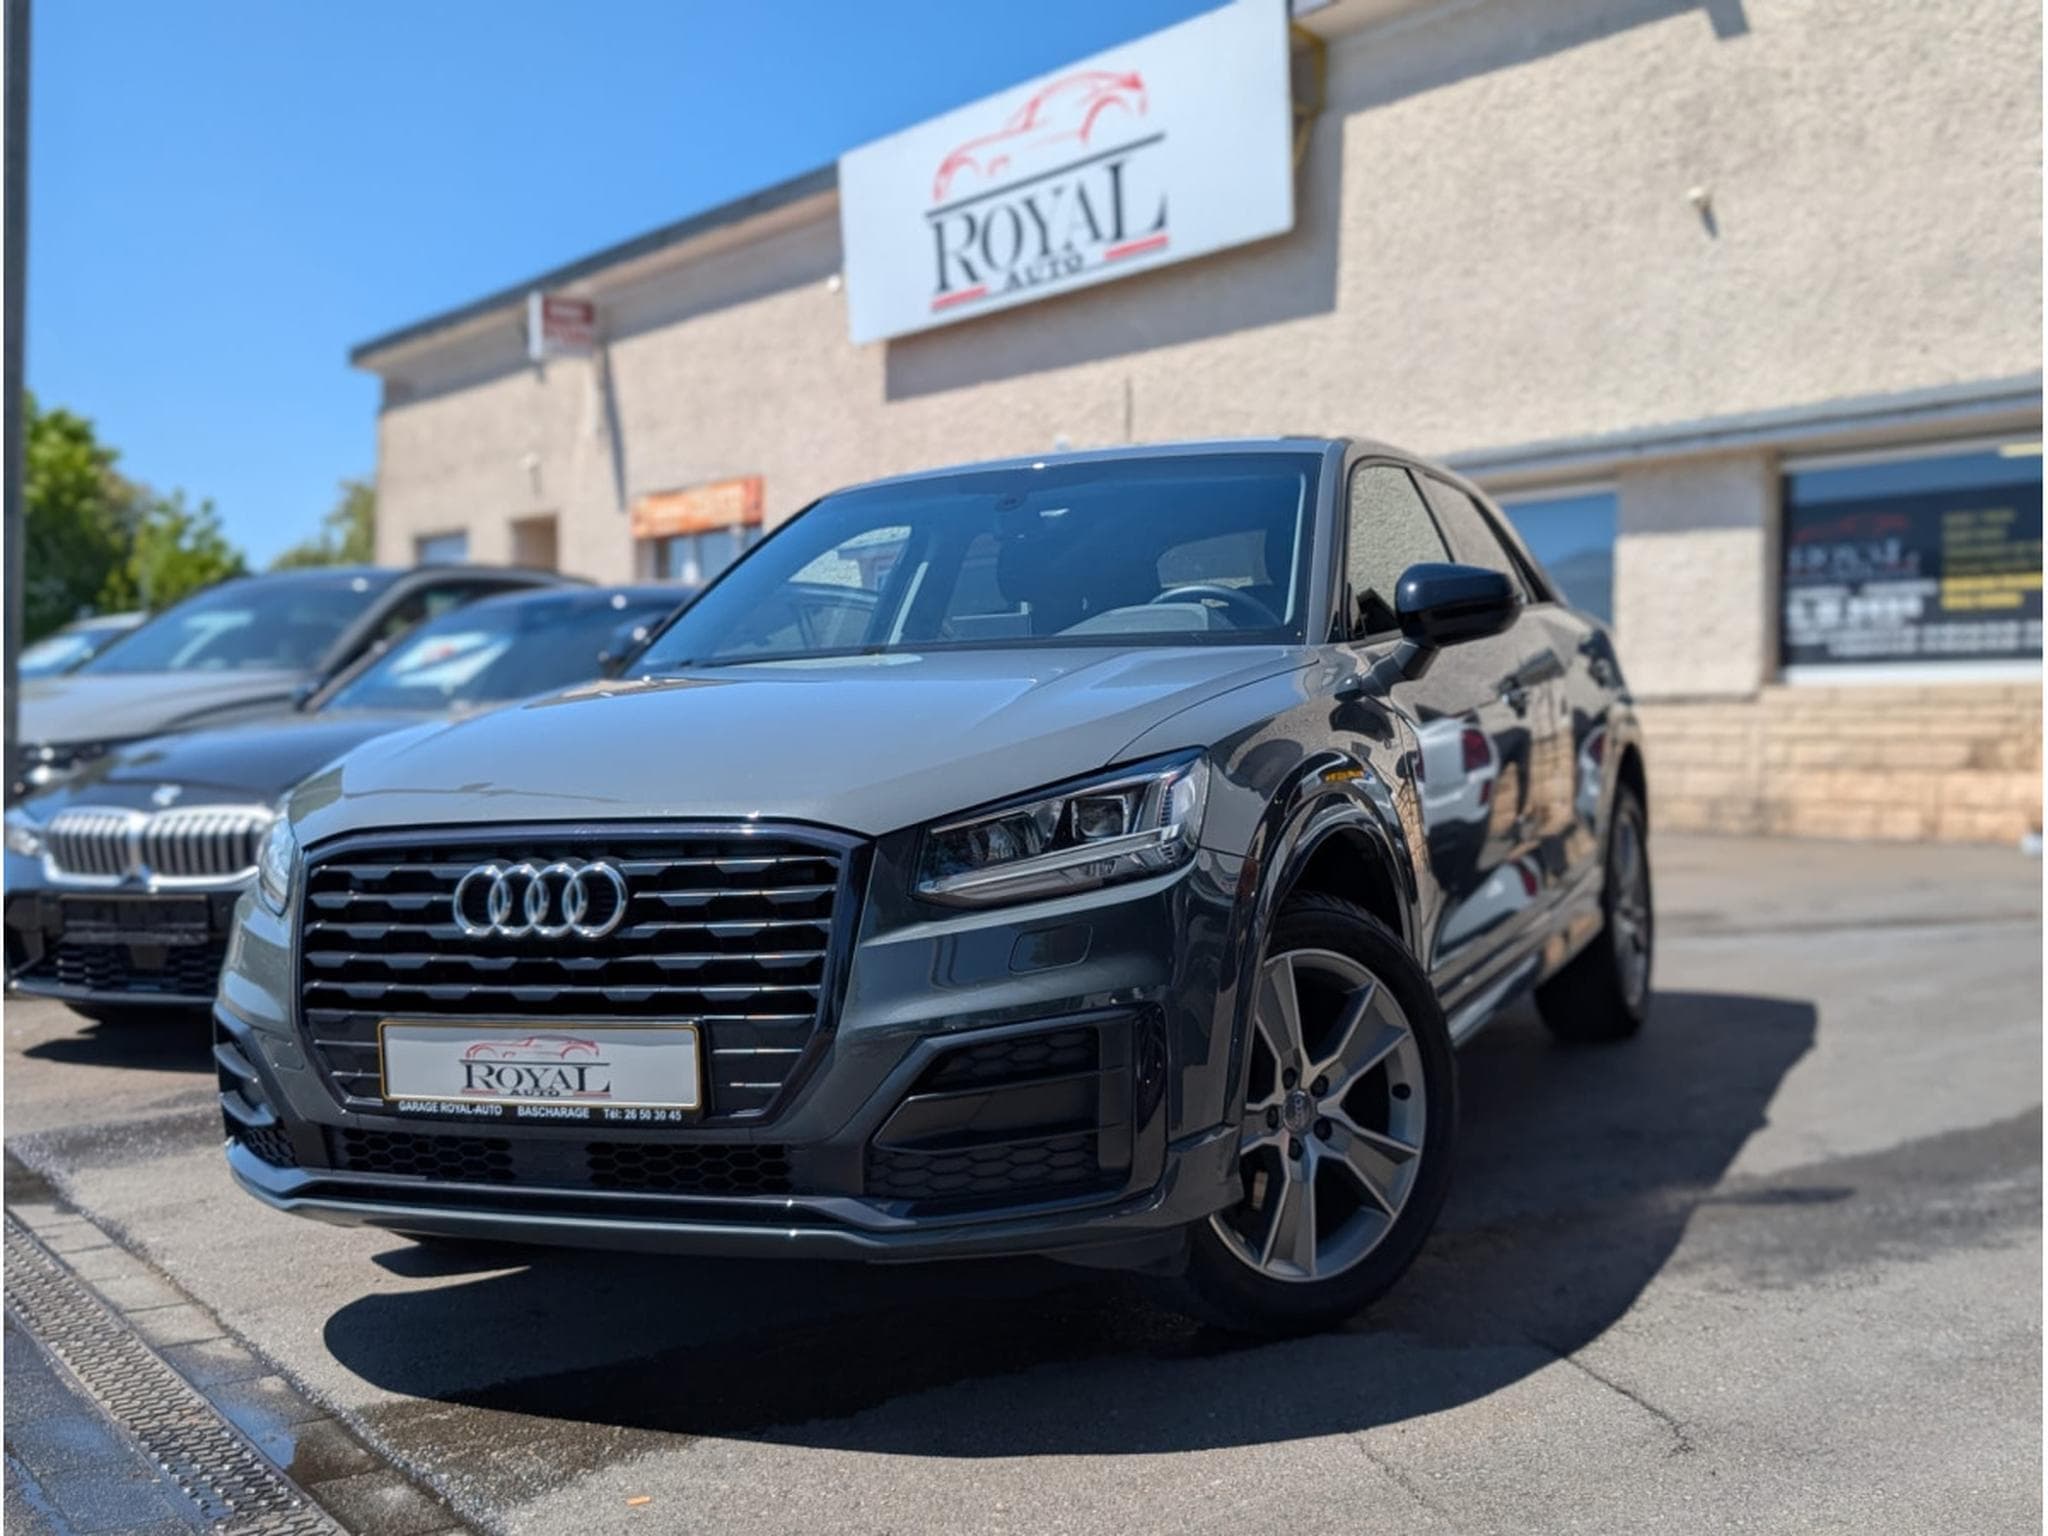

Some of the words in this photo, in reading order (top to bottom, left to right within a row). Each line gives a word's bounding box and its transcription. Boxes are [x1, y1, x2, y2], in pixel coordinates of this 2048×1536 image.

[930, 160, 1169, 294] ROYAL
[1003, 252, 1085, 293] AUTO
[465, 1062, 611, 1093] ROYAL
[509, 1088, 561, 1098] AUTO
[398, 1100, 439, 1113] GARAGE
[440, 1102, 503, 1116] ROYAL-AUTO
[517, 1105, 591, 1119] BASCHARAGE
[624, 1109, 637, 1120] 26
[639, 1109, 651, 1121] 50
[653, 1110, 666, 1121] 30
[668, 1110, 682, 1121] 45
